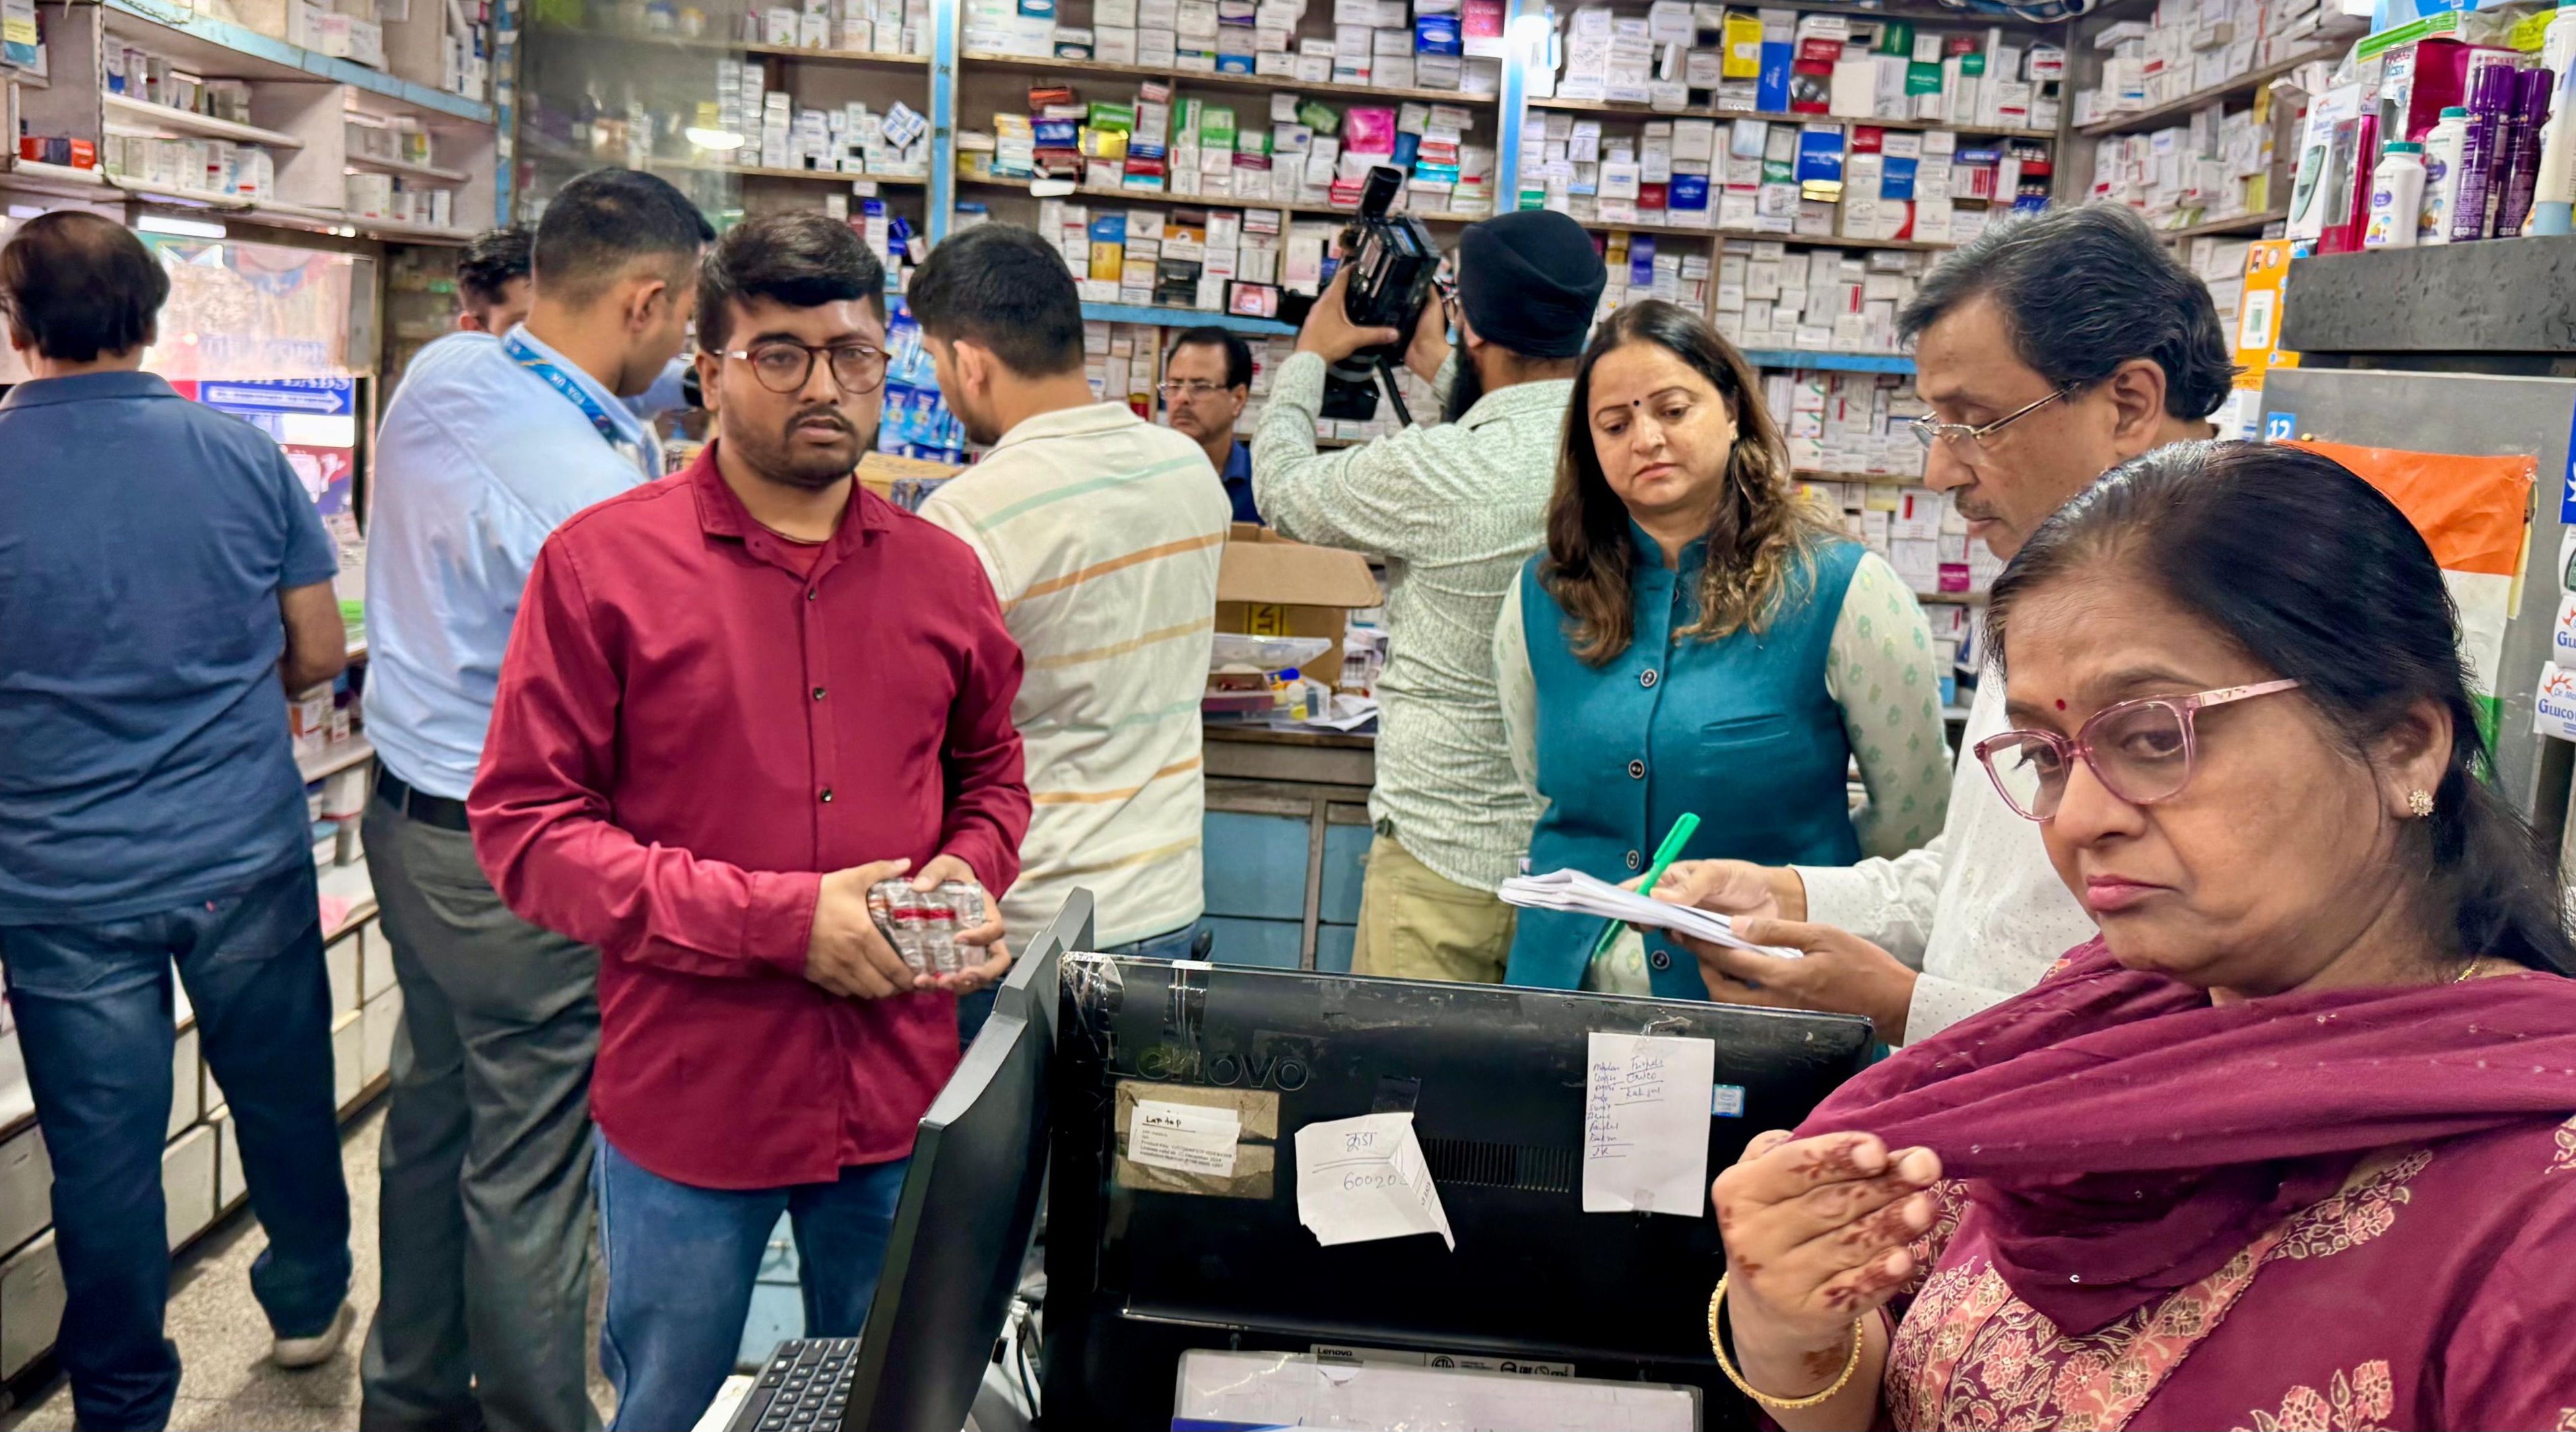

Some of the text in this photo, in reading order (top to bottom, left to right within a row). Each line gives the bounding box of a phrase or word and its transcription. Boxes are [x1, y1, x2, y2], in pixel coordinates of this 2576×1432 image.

[2270, 419, 2290, 440] 12
[1103, 1032, 1309, 1091] Lenovo
[1317, 1346, 1352, 1357] Lenovo
